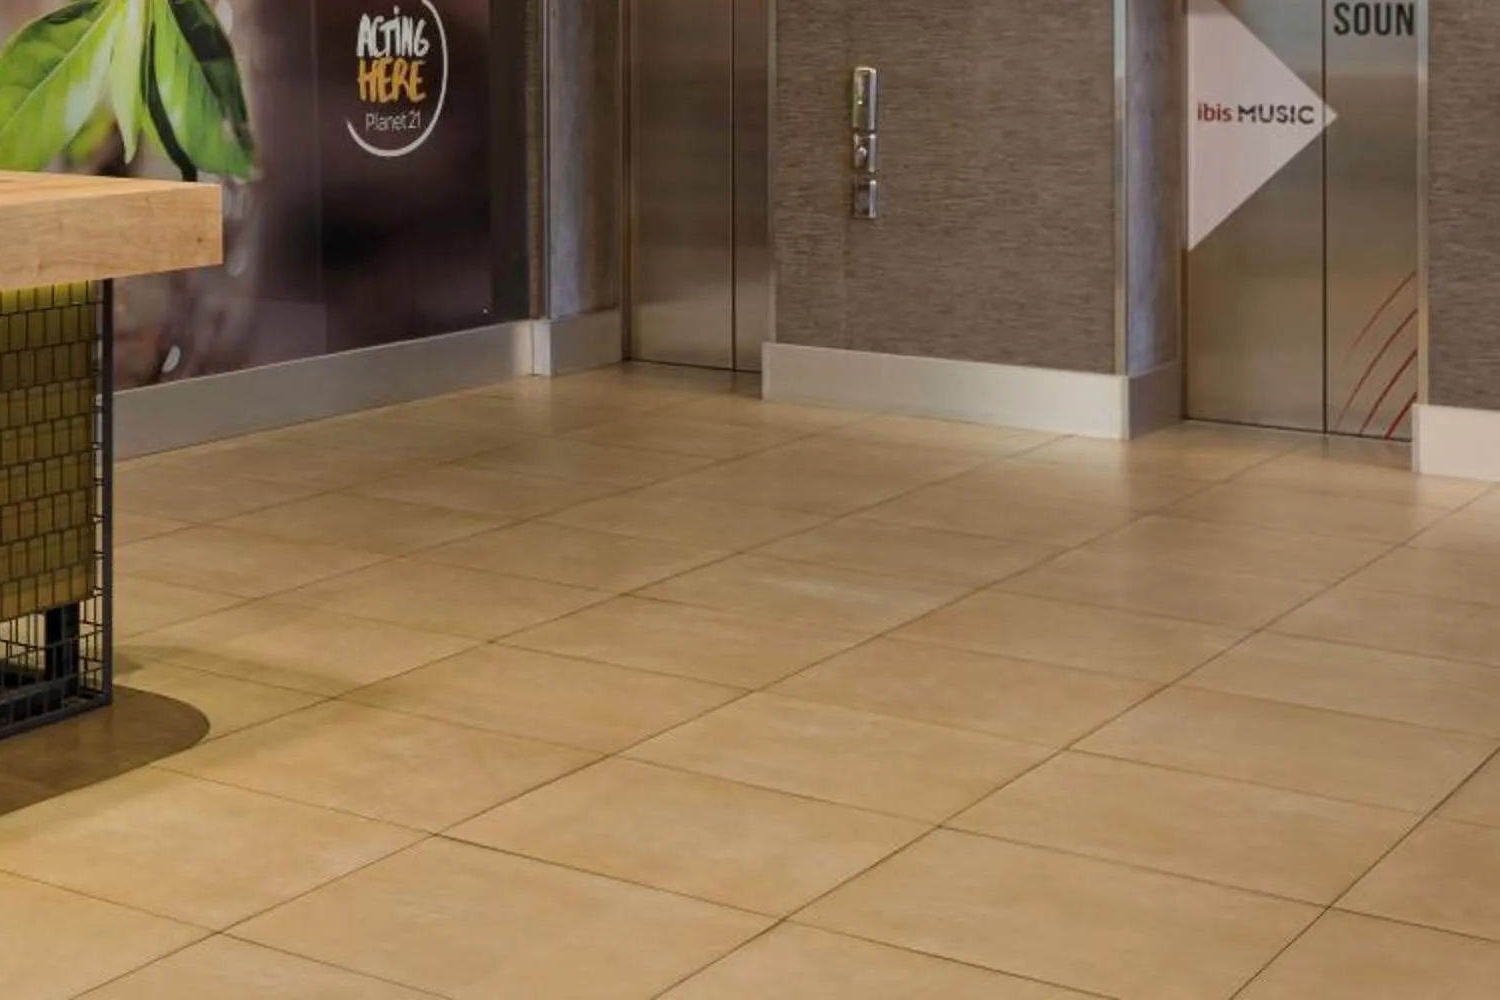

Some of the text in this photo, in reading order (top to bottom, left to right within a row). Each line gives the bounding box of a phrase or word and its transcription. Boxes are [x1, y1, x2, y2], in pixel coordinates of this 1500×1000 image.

[356, 56, 429, 105] HERE
[365, 110, 422, 133] Planet 21
[1196, 101, 1315, 125] ibis MUSIC
